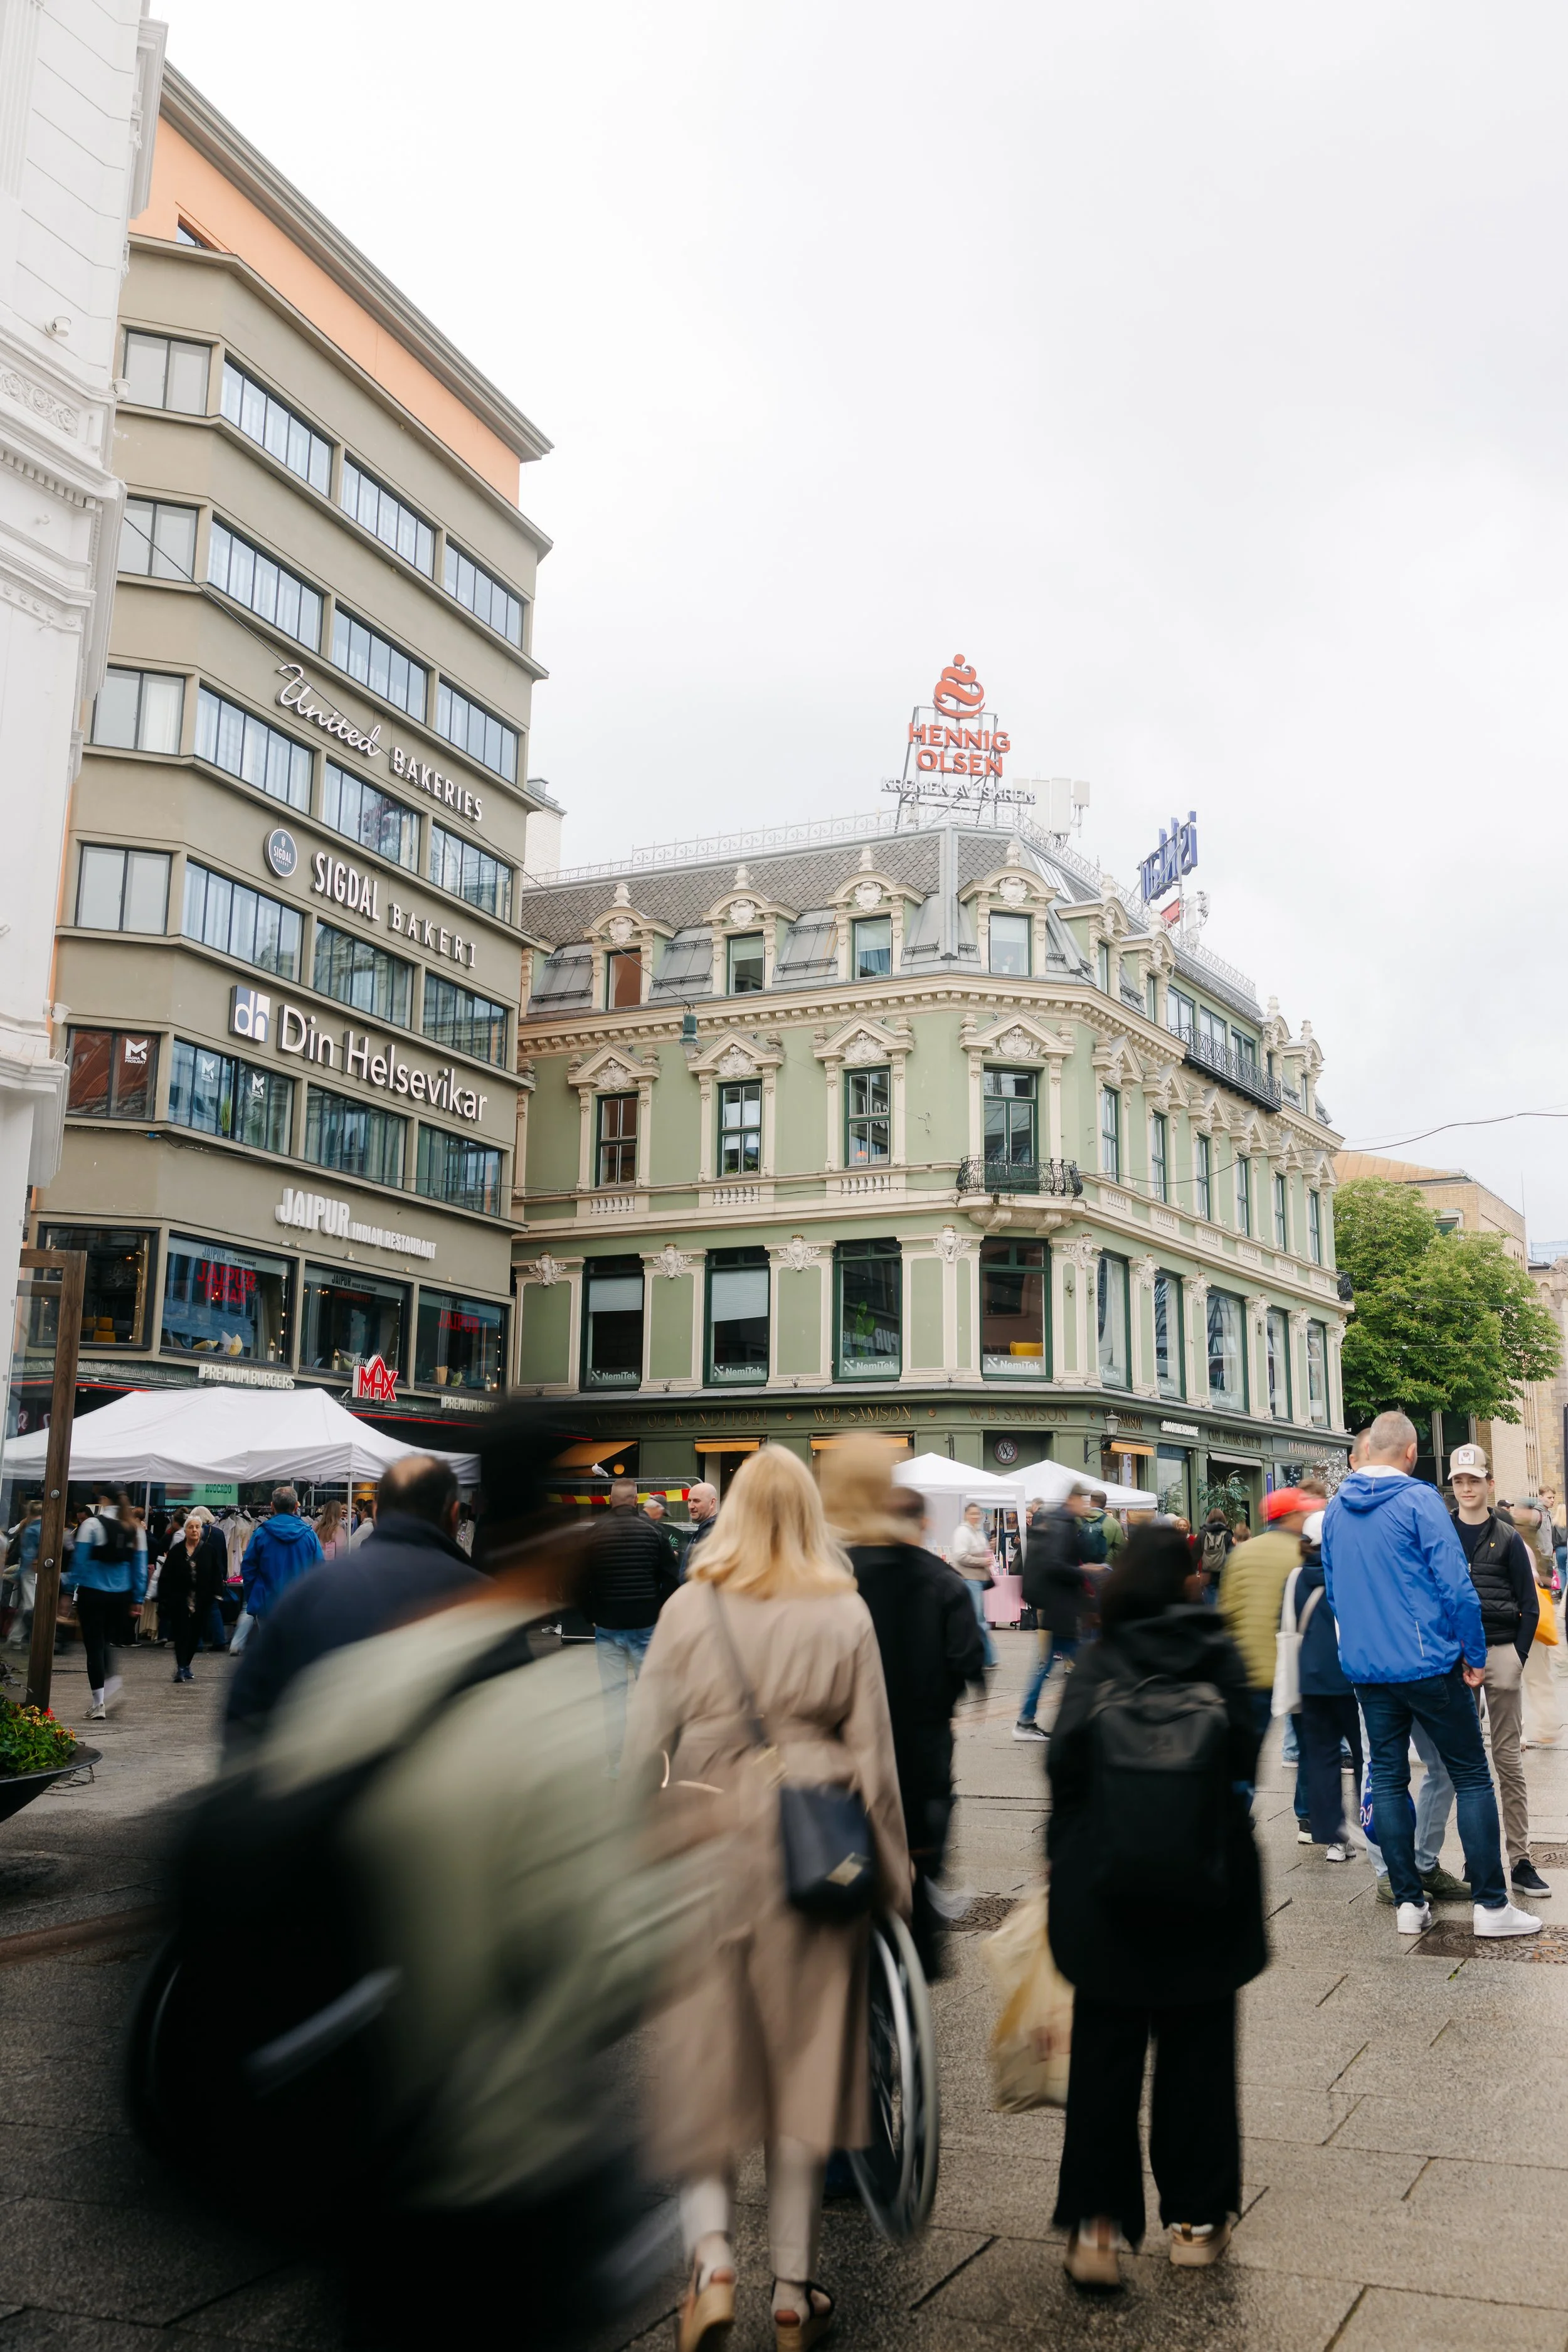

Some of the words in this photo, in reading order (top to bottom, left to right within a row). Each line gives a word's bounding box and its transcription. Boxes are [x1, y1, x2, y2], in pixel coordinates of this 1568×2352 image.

[276, 664, 381, 756] United
[390, 747, 482, 822] BAKERIES
[908, 723, 1010, 753] HENNIG
[917, 750, 1002, 778] OLSEN
[881, 777, 950, 797] KREMEN
[977, 785, 1037, 805] ISKREM
[273, 845, 292, 864] SIGDAL
[313, 851, 380, 921] SIGDAL
[389, 903, 477, 968] BAKERI
[278, 1004, 334, 1066] Din
[343, 1030, 487, 1121] Helsevikar
[275, 1188, 350, 1238] JAIPUR
[349, 1222, 383, 1246] INDIAN
[381, 1231, 437, 1259] RESTAURANT
[203, 1246, 225, 1261] JAIPUR
[197, 1261, 256, 1292] JAIPUR
[332, 1274, 351, 1288] JAIPUR
[204, 1284, 246, 1305] INDIAN
[437, 1310, 479, 1334] JAIPUR
[603, 1371, 637, 1380] NemiTek
[726, 1366, 762, 1377] NemiTek
[857, 1361, 894, 1370] NemiTek
[1000, 1360, 1040, 1371] NemiTek
[199, 1364, 248, 1384] PREMIUM
[251, 1370, 295, 1390] BURGERS
[356, 1355, 399, 1402] MAX
[442, 1396, 477, 1412] PREMIUM
[479, 1401, 499, 1413] BUR
[848, 1406, 911, 1422] SAMSON
[1004, 1406, 1067, 1422] SAMSON
[647, 1413, 667, 1428] OG
[674, 1410, 768, 1428] KONDITORI
[1118, 1412, 1143, 1431] SAMSON
[1208, 1428, 1221, 1443] CARL
[1222, 1430, 1242, 1446] JOHANS
[1242, 1434, 1255, 1449] GATE
[205, 1483, 232, 1494] AVOCADO
